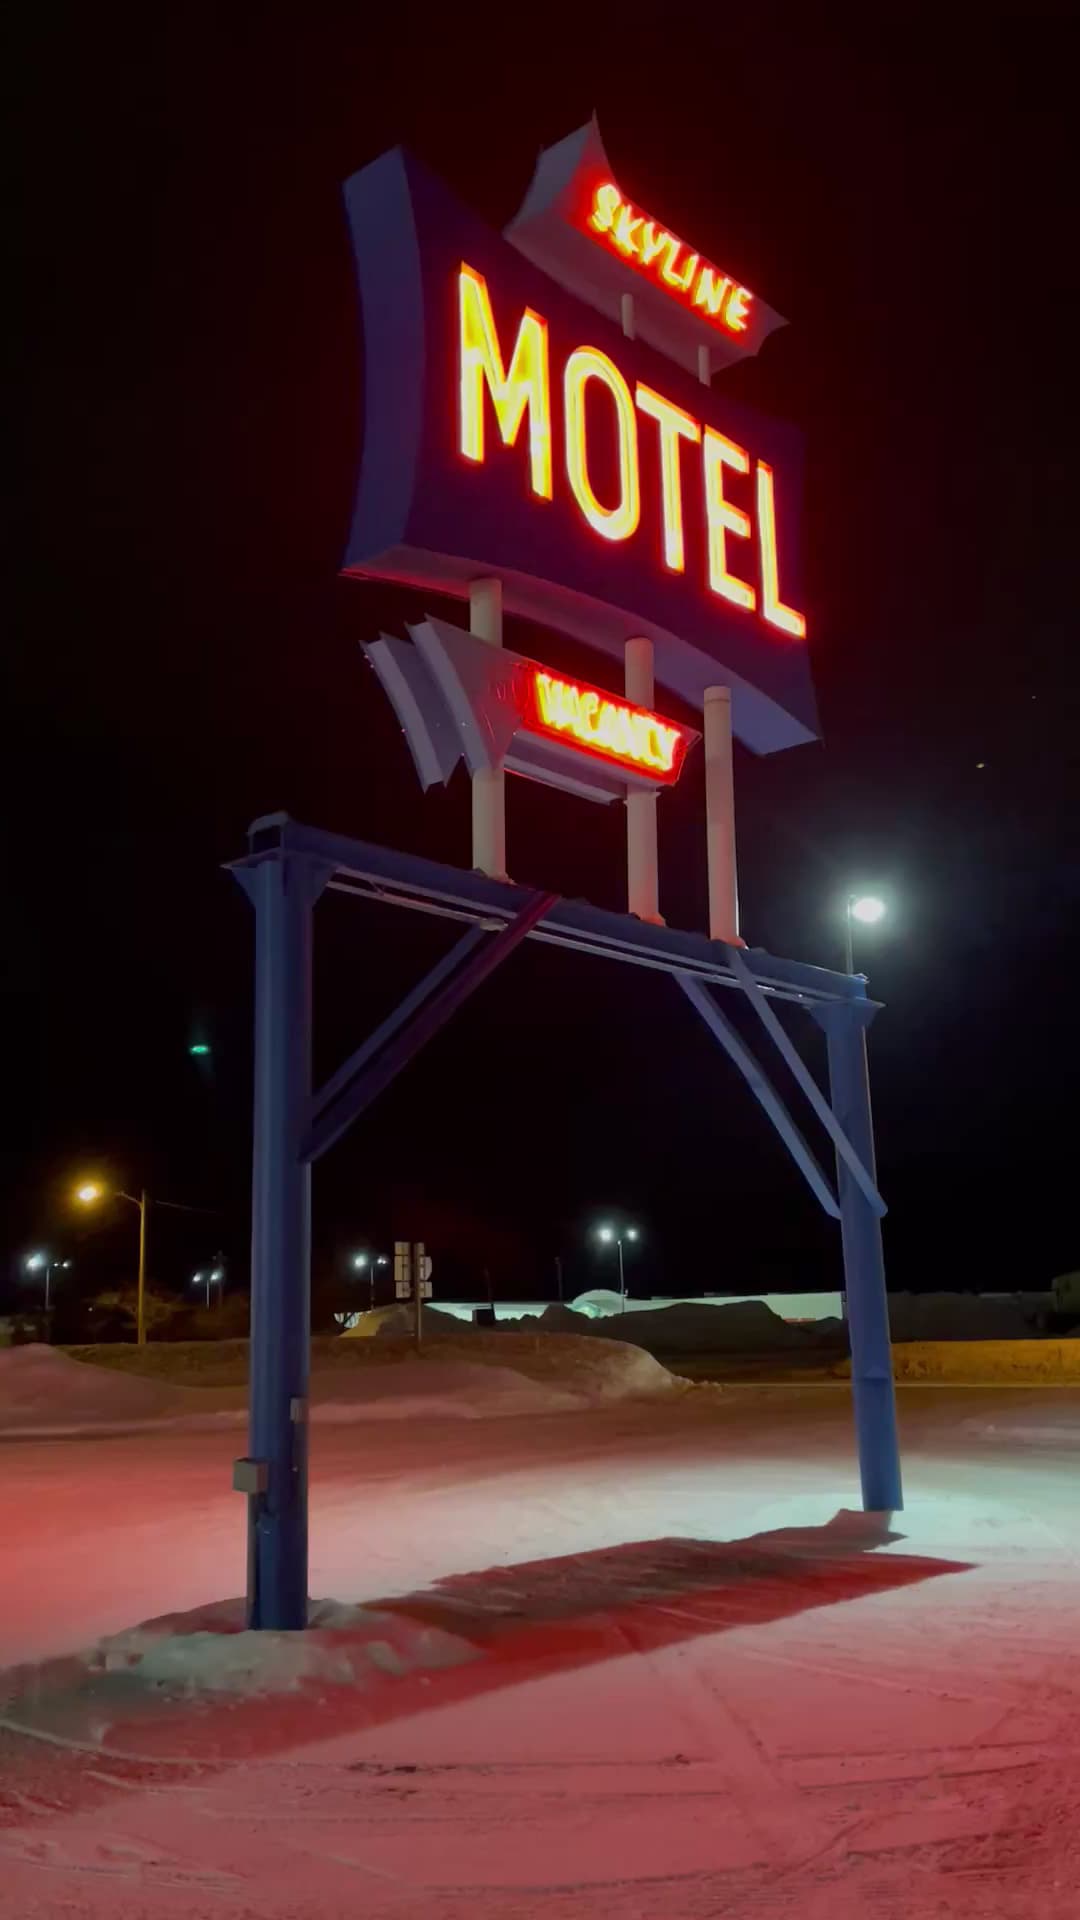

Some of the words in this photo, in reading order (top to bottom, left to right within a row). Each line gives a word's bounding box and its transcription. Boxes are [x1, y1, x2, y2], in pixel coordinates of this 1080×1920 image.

[592, 183, 752, 331] SKYLINE
[459, 261, 806, 639] MOTEL
[535, 671, 681, 773] VACANCY
